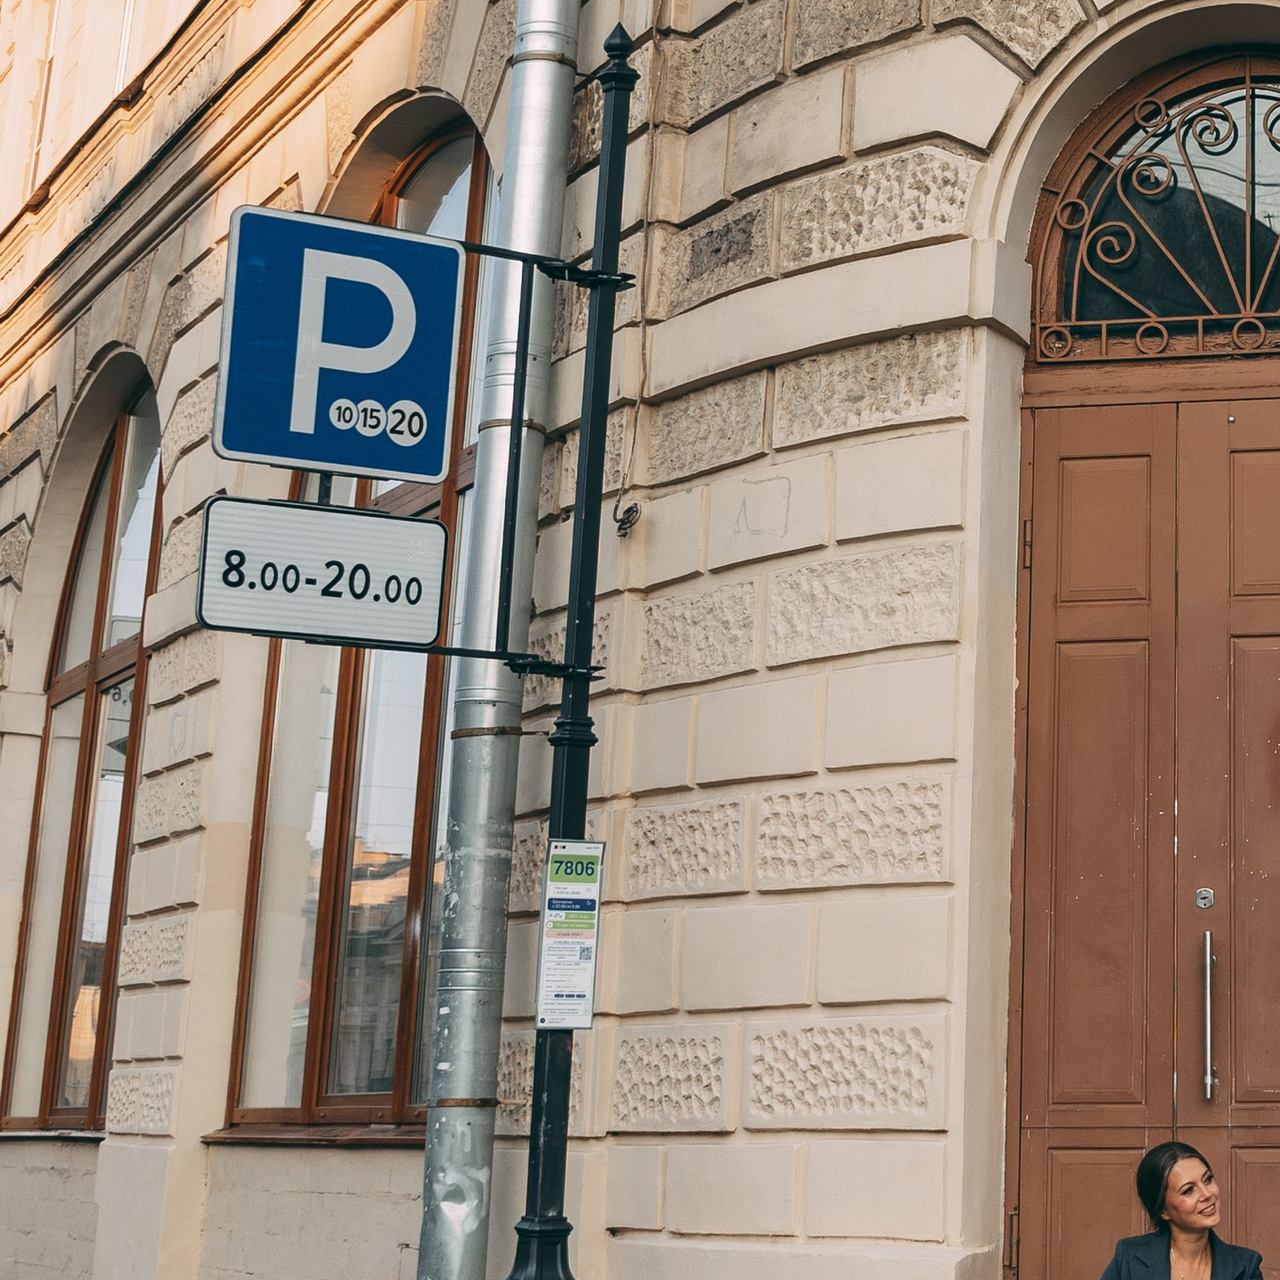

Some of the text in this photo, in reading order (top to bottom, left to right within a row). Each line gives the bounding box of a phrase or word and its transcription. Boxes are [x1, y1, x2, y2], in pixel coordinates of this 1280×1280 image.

[289, 247, 417, 435] P
[335, 405, 424, 438] 10 15 20
[222, 549, 423, 606] 8.00-20.00
[553, 860, 595, 877] 7806
